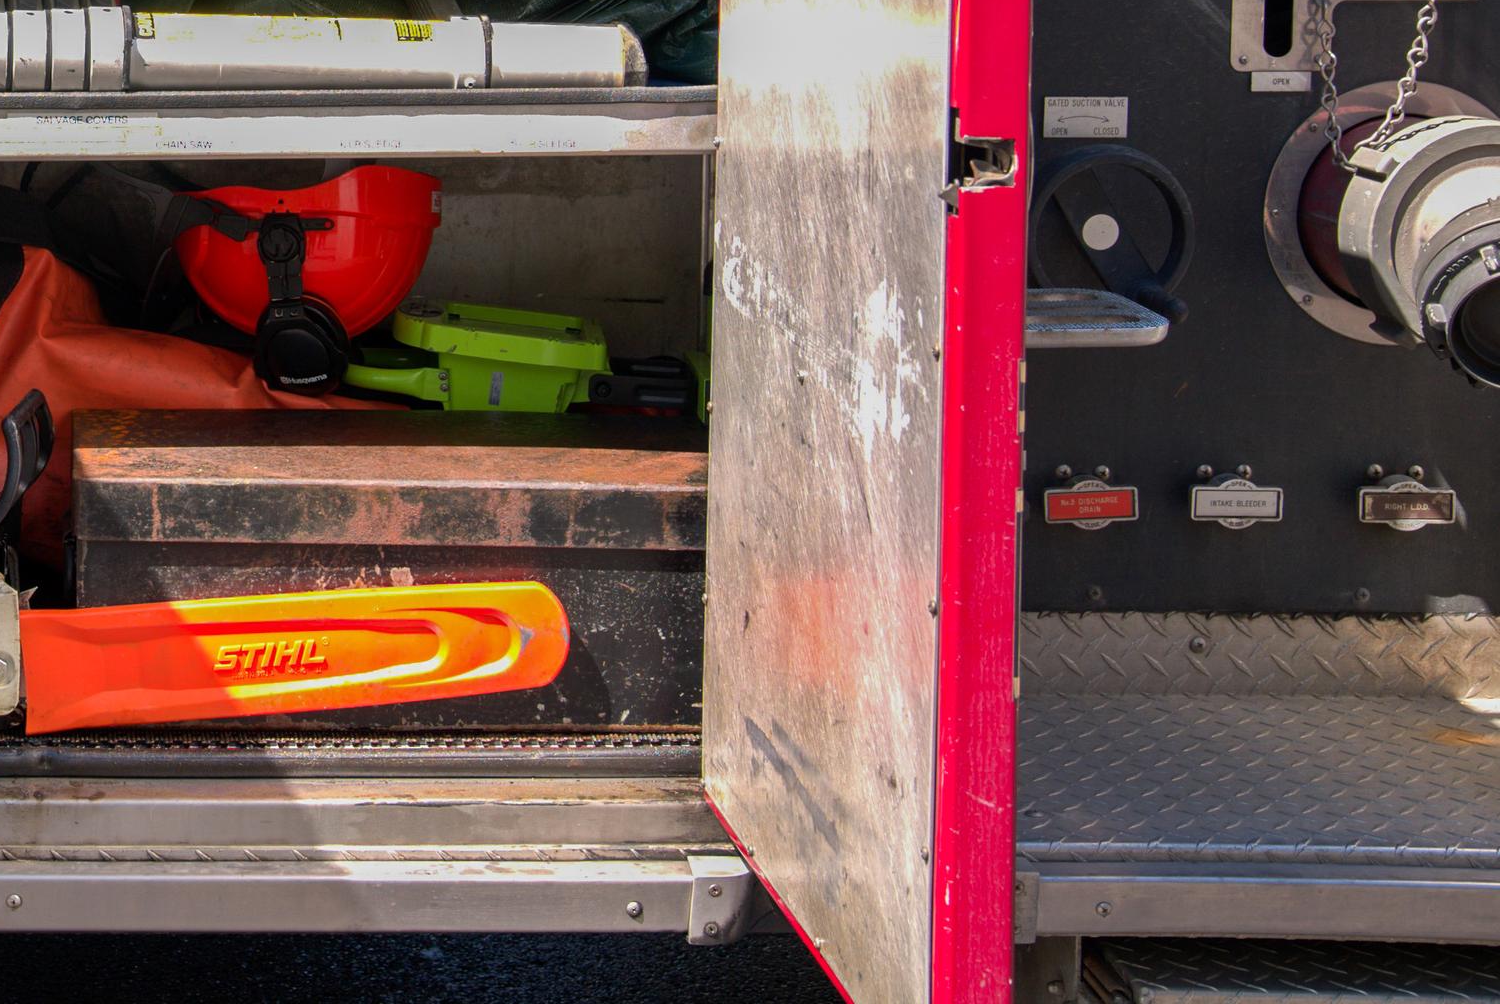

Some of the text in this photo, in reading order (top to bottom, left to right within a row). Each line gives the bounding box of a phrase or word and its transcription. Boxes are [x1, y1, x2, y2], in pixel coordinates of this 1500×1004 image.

[1272, 77, 1290, 85] OPEN
[1047, 98, 1125, 108] GATED SUCTION VALVE
[1051, 127, 1068, 136] OPEN
[1093, 127, 1120, 136] CLOSED
[1077, 496, 1119, 506] DISCHARGE
[1210, 499, 1267, 508] INTAKE BLEEDER
[1078, 506, 1102, 514] DRAIN
[1384, 502, 1407, 511] RIGHT
[213, 638, 326, 671] STIHL
